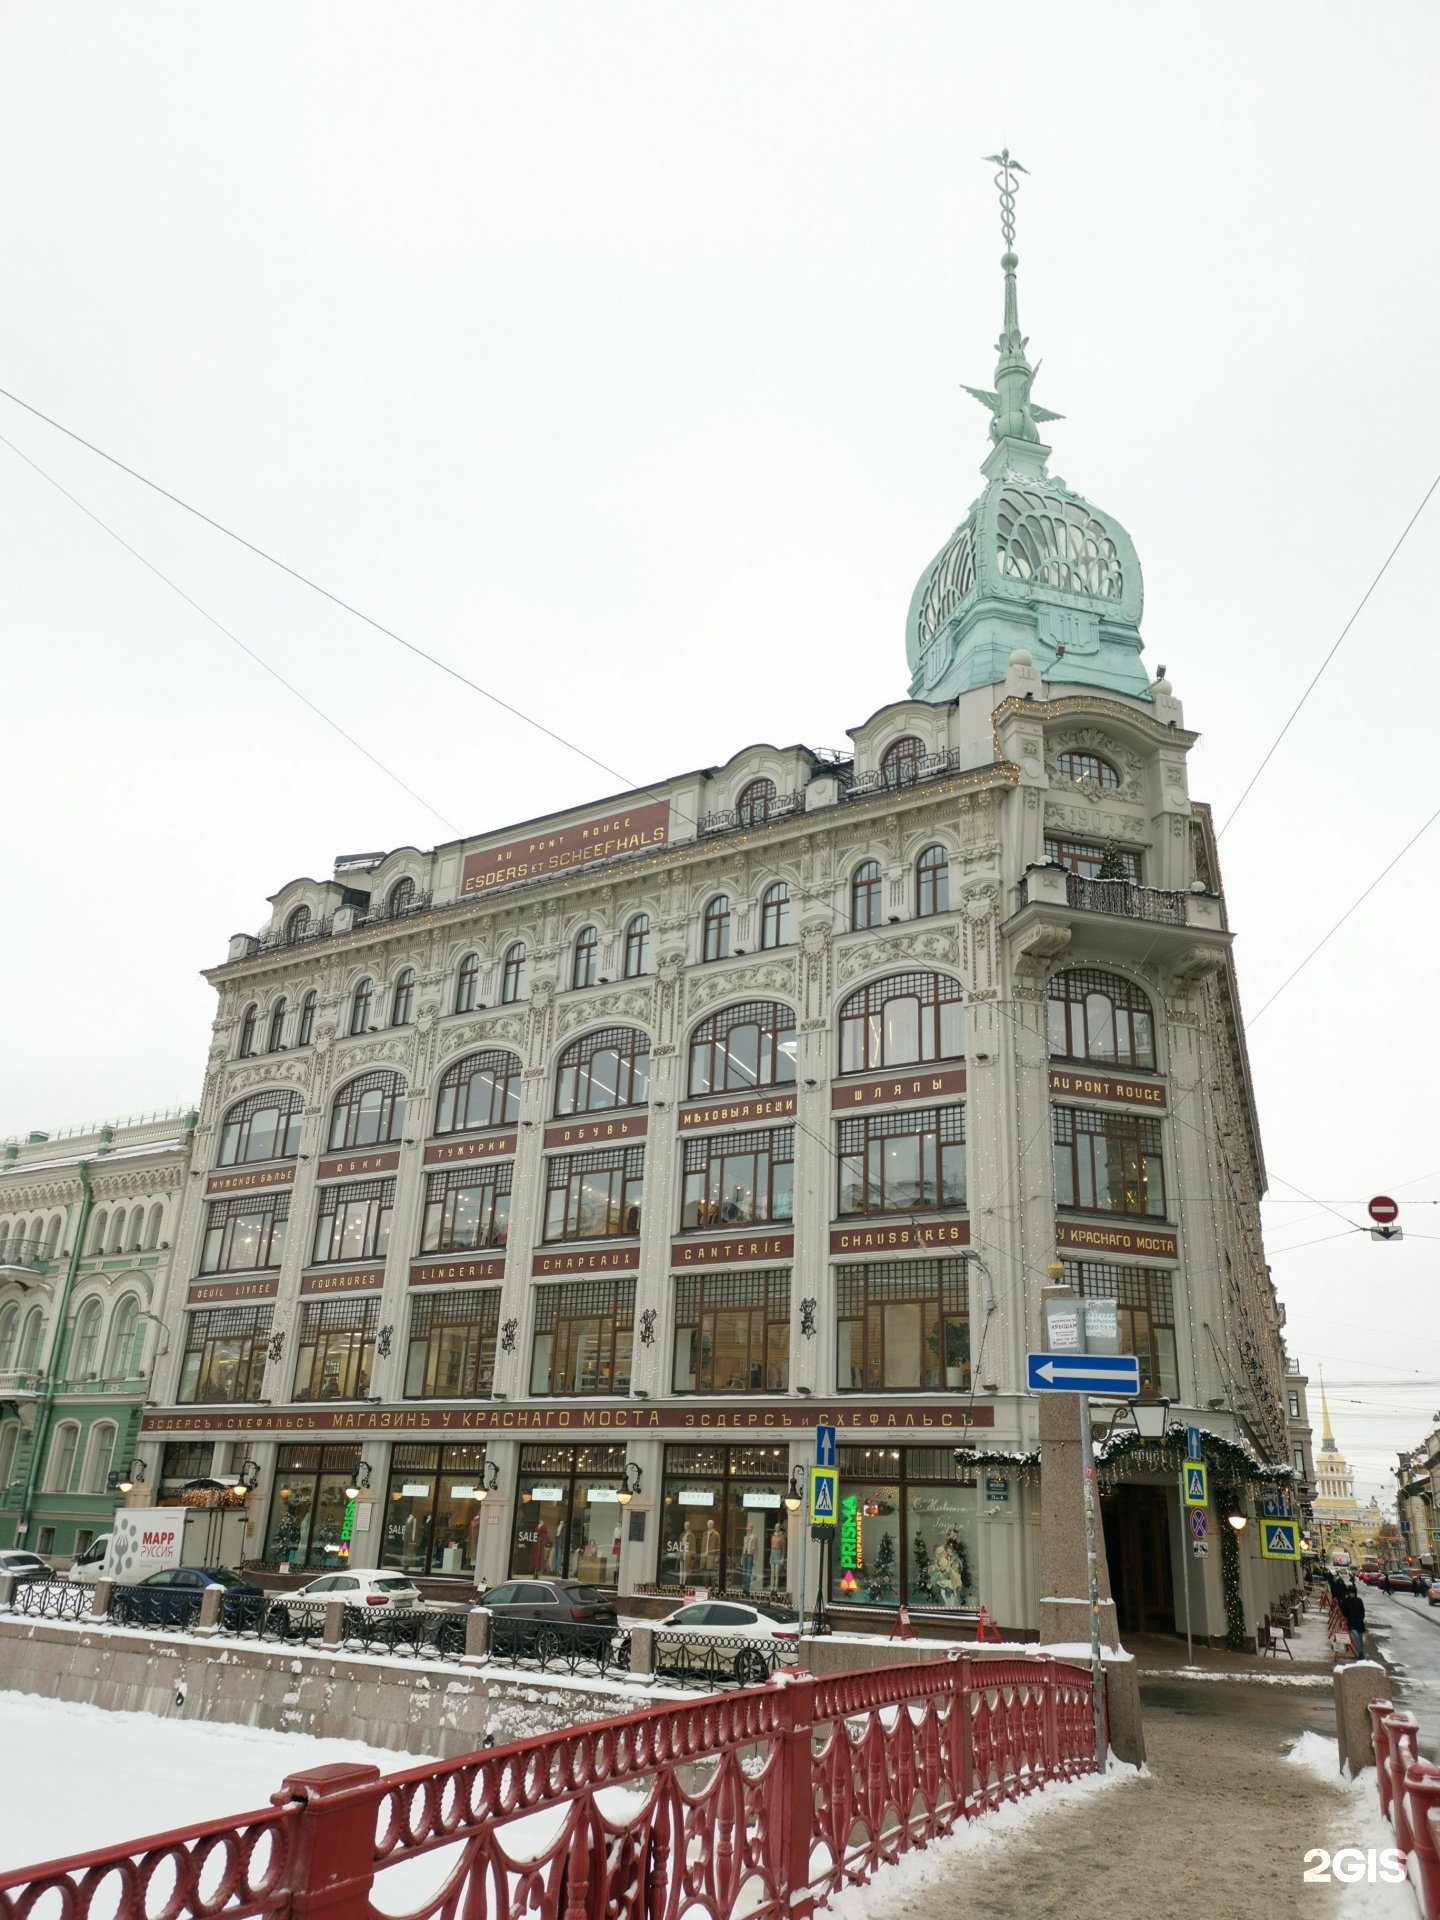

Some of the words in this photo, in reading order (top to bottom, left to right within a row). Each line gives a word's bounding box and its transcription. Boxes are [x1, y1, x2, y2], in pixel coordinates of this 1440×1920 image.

[1070, 808, 1117, 832] 1907
[497, 851, 512, 862] AU
[529, 837, 564, 853] PONT
[583, 819, 630, 838] ROUGE
[465, 864, 527, 891] ESDERS
[531, 862, 544, 873] ET
[549, 827, 665, 869] SCHEEFHALS
[854, 1079, 942, 1101] ШЛЯПЫ
[1053, 1077, 1070, 1089] AU
[1075, 1080, 1110, 1094] PONT
[1116, 1085, 1161, 1101] ROUGE
[756, 1100, 793, 1114] ВЕЩИ
[564, 1123, 628, 1141] ОБУВЬ
[437, 1140, 505, 1158] ТУЖУРКИ
[1058, 1229, 1065, 1240] У
[1070, 1230, 1131, 1247] КРАСНАГО
[1136, 1237, 1175, 1252] МОСТА
[543, 1253, 630, 1270] CHAPEAUX
[311, 1274, 375, 1289] FOURRURES
[197, 1288, 223, 1299] DEUIL
[235, 1283, 270, 1296] LIVREE
[148, 1419, 211, 1430] ЭСДЕРСЪ
[227, 1418, 315, 1429] СХЕФАЛЬСЪ
[332, 1413, 430, 1427] МАГАЗИНЪ
[442, 1412, 451, 1427] У
[462, 1411, 570, 1427] КРАСНАГО
[583, 1410, 659, 1426] МОСТА
[685, 1414, 792, 1427] ЭСДЕРСЪ
[801, 1417, 809, 1426] и
[818, 1413, 974, 1427] СХЕФАЛЬСЪ
[388, 1524, 406, 1535] SALE
[518, 1531, 538, 1542] SALE
[841, 1495, 857, 1569] PRISMA
[141, 1545, 174, 1558] РУССИЯ
[666, 1540, 690, 1552] SALE
